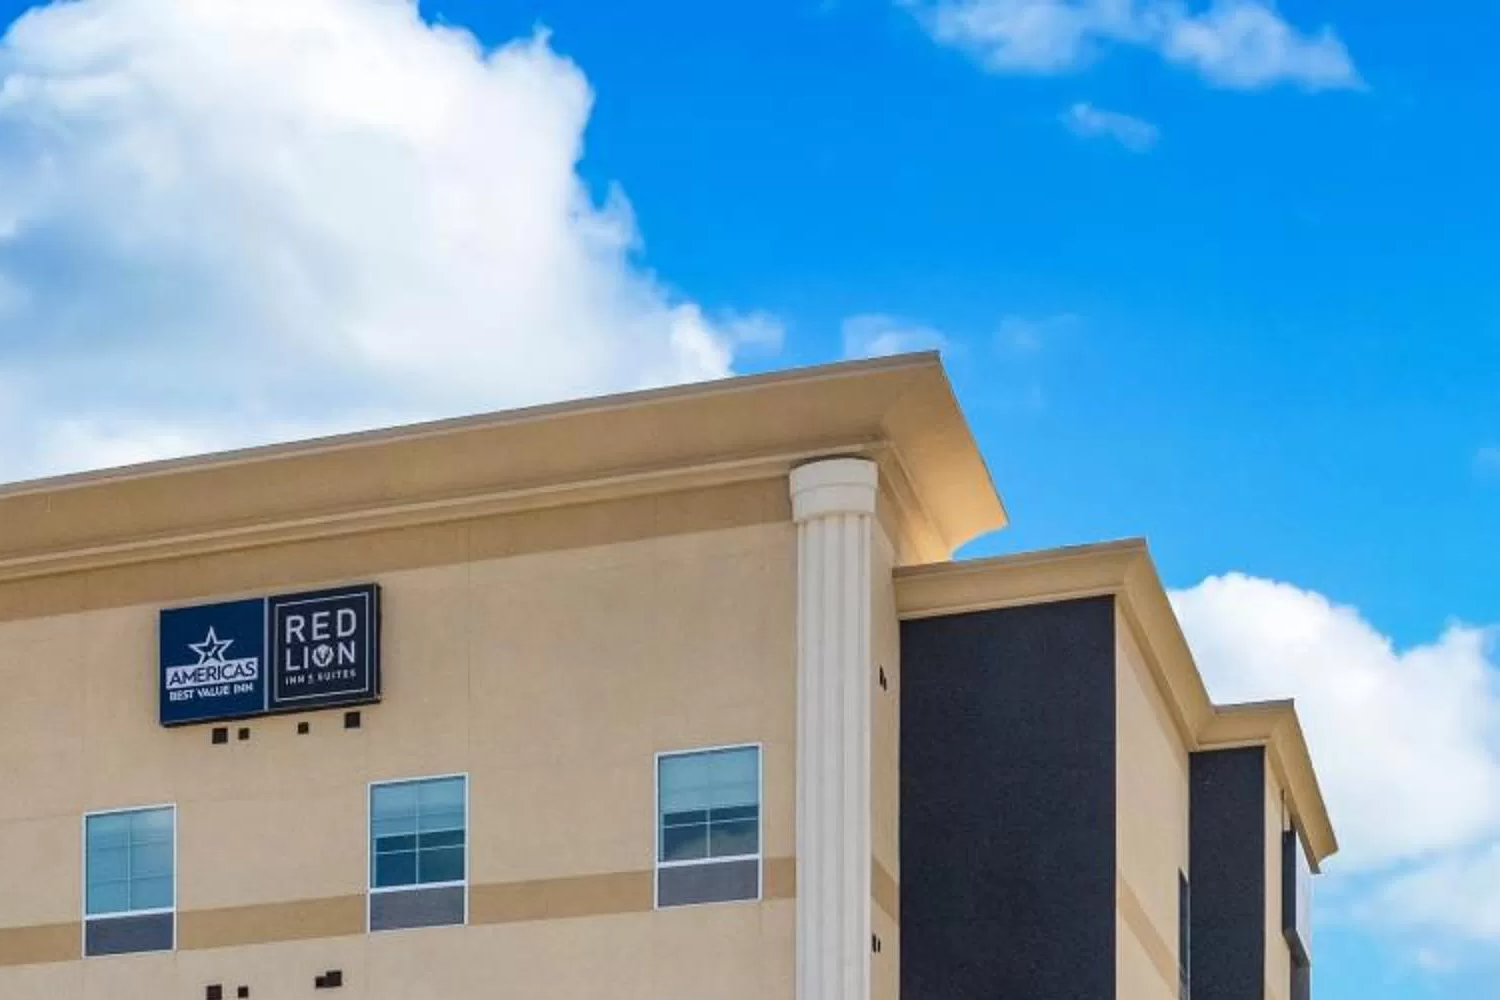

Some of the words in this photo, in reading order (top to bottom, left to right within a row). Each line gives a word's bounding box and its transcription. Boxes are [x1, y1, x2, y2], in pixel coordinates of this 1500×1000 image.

[286, 608, 357, 643] RED
[286, 640, 355, 671] LION
[169, 661, 256, 686] AMERICAS
[317, 669, 357, 681] SUITES
[169, 689, 195, 702] BEST
[197, 684, 230, 697] VALUE
[233, 682, 254, 695] INN
